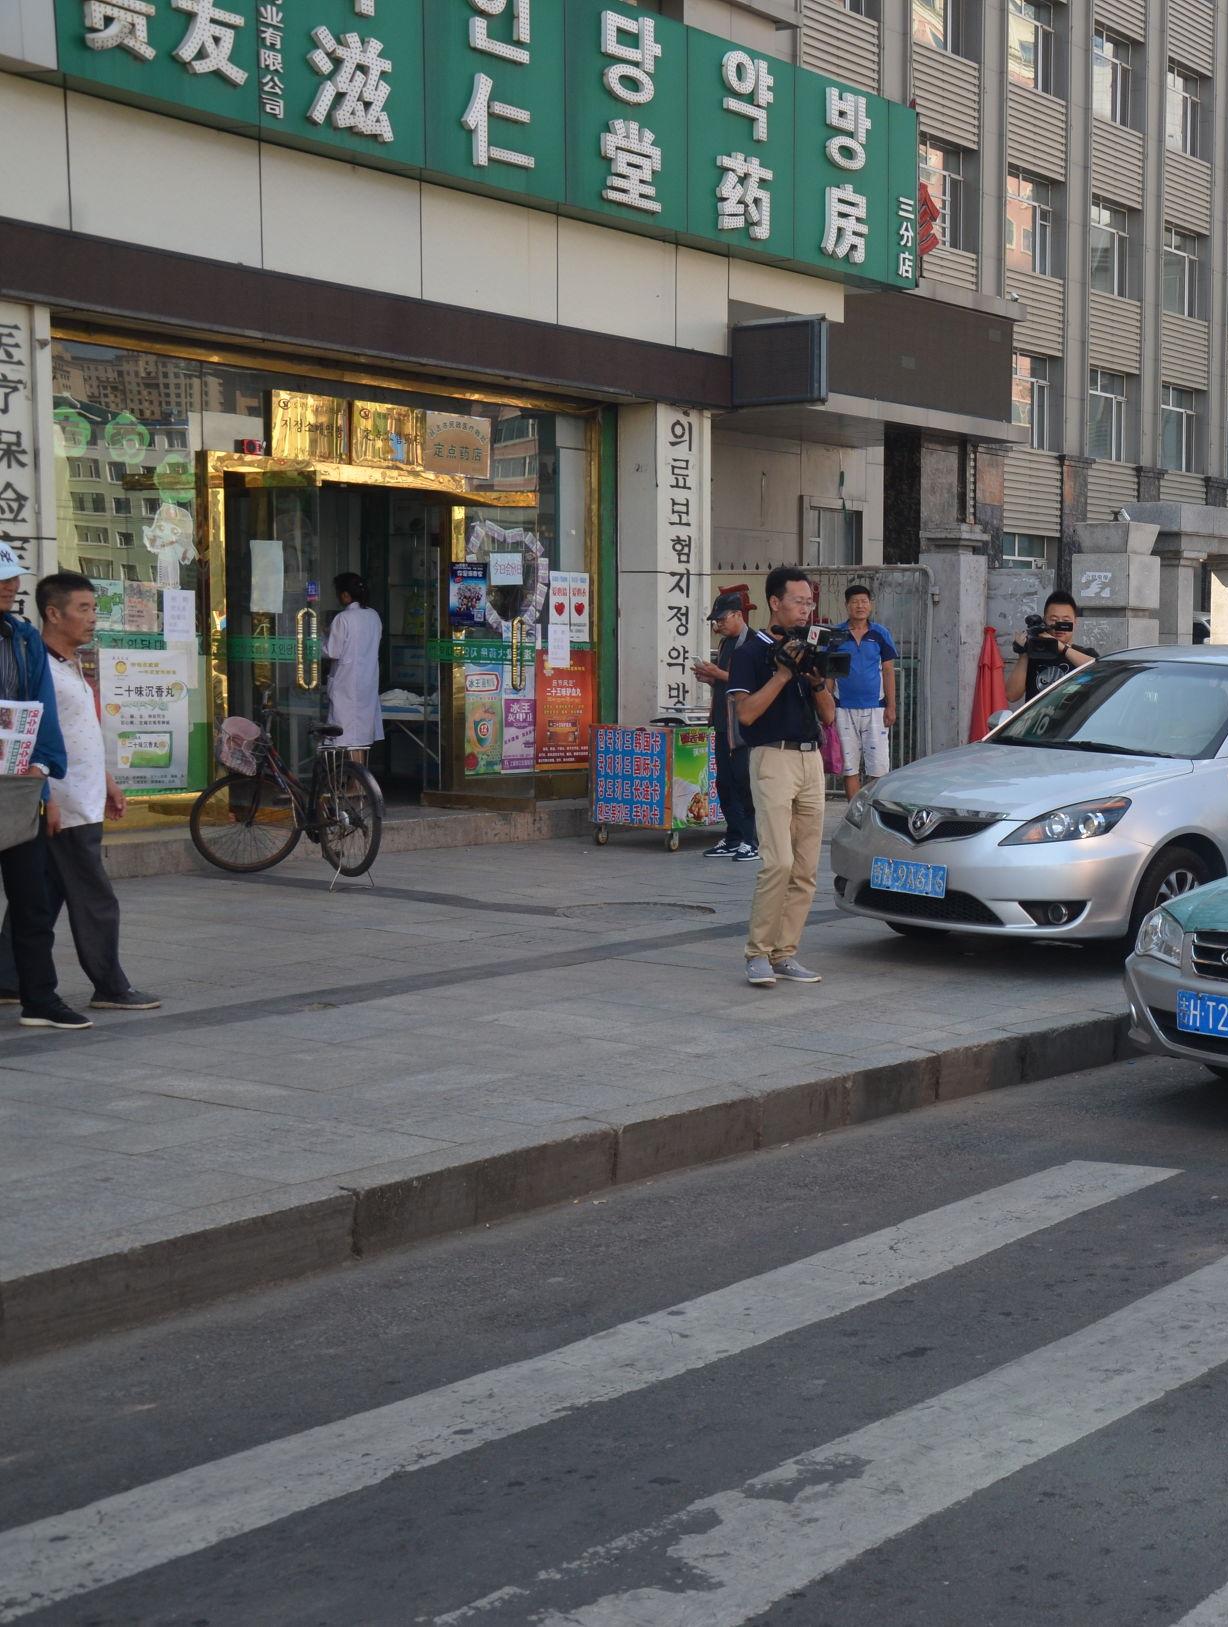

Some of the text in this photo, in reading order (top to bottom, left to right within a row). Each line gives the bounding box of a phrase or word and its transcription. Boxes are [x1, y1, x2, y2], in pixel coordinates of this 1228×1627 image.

[259, 0, 285, 119] 业有限公司
[307, 25, 869, 265] 滋仁堂药房
[897, 197, 914, 279] 三分店
[434, 442, 483, 461] 定点药店
[667, 419, 693, 712] 의료보험지정약방
[114, 685, 175, 698] 二十味沉香丸
[510, 702, 531, 713] 冰王
